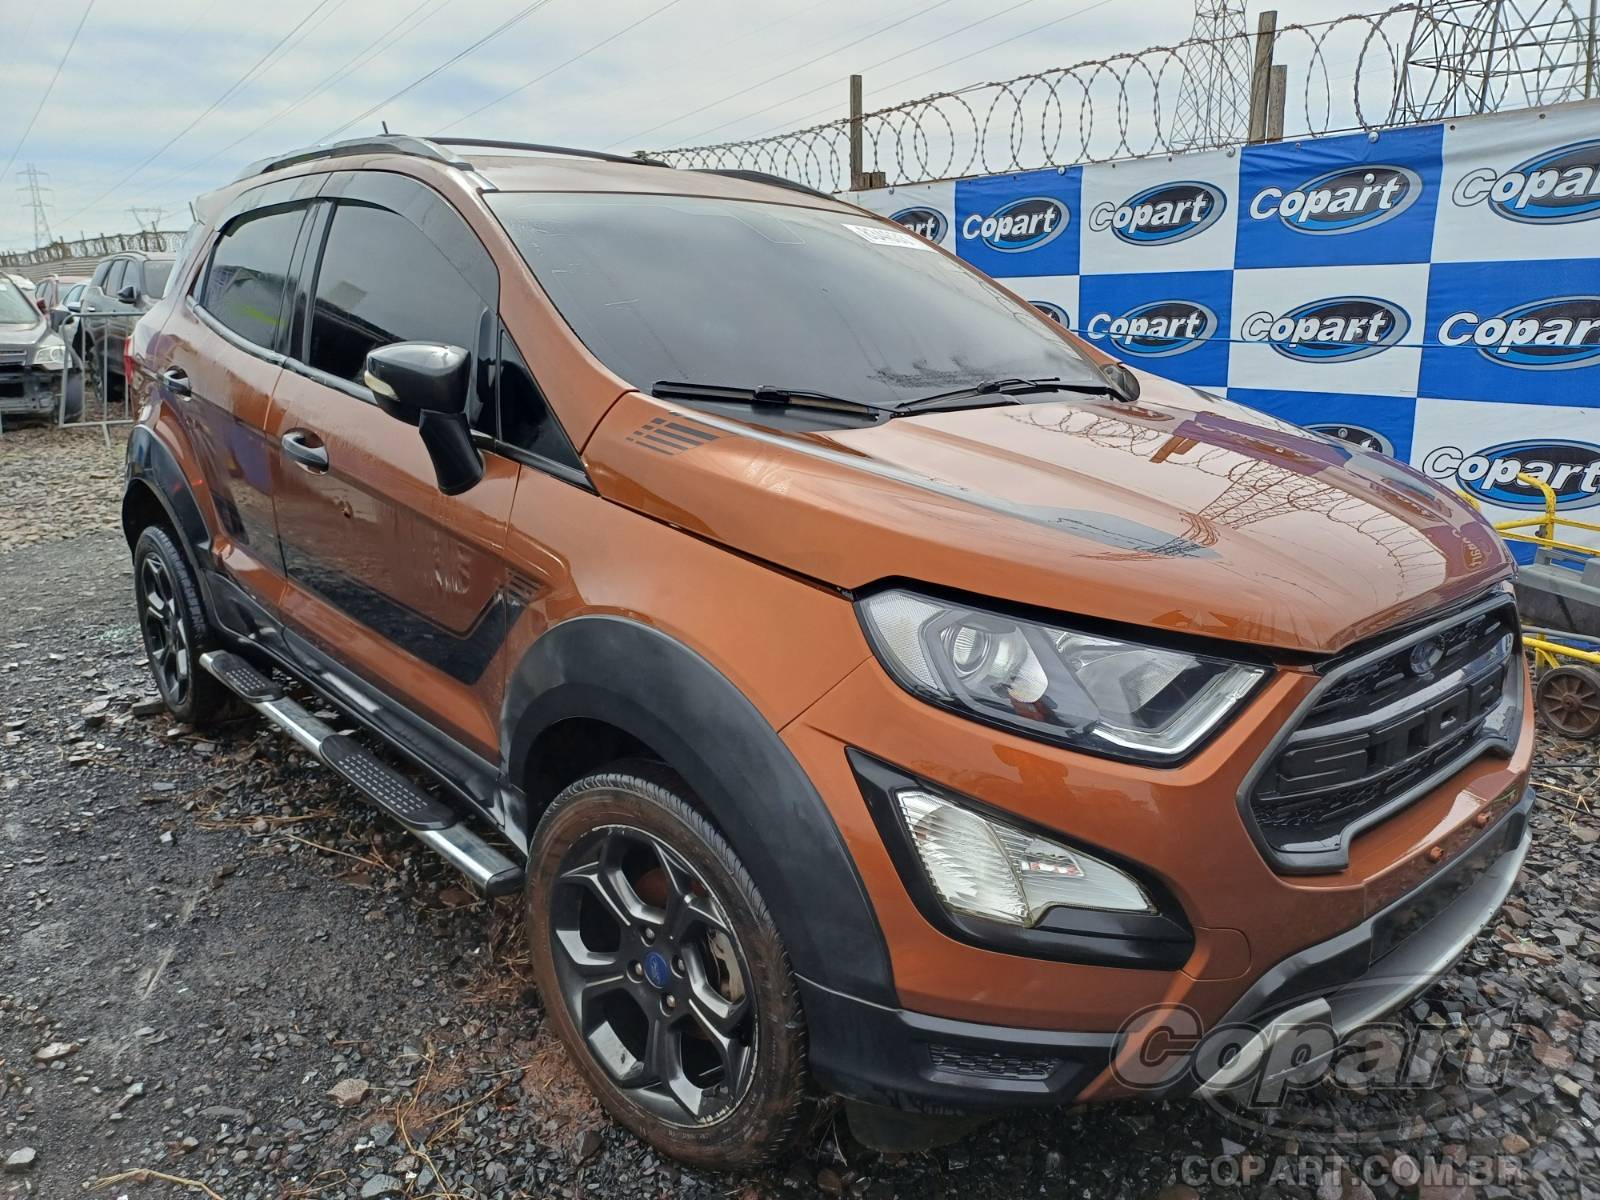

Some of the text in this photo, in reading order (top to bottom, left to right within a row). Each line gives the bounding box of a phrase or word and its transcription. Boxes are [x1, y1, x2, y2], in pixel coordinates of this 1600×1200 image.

[1249, 175, 1400, 222] Copart
[1452, 166, 1600, 209] Copa
[962, 206, 1056, 243] Copart
[1090, 190, 1209, 232] Copart
[1087, 311, 1201, 344] Copart
[1240, 308, 1388, 348] Copart
[1437, 311, 1600, 354] Copar
[1422, 446, 1600, 493] Copart
